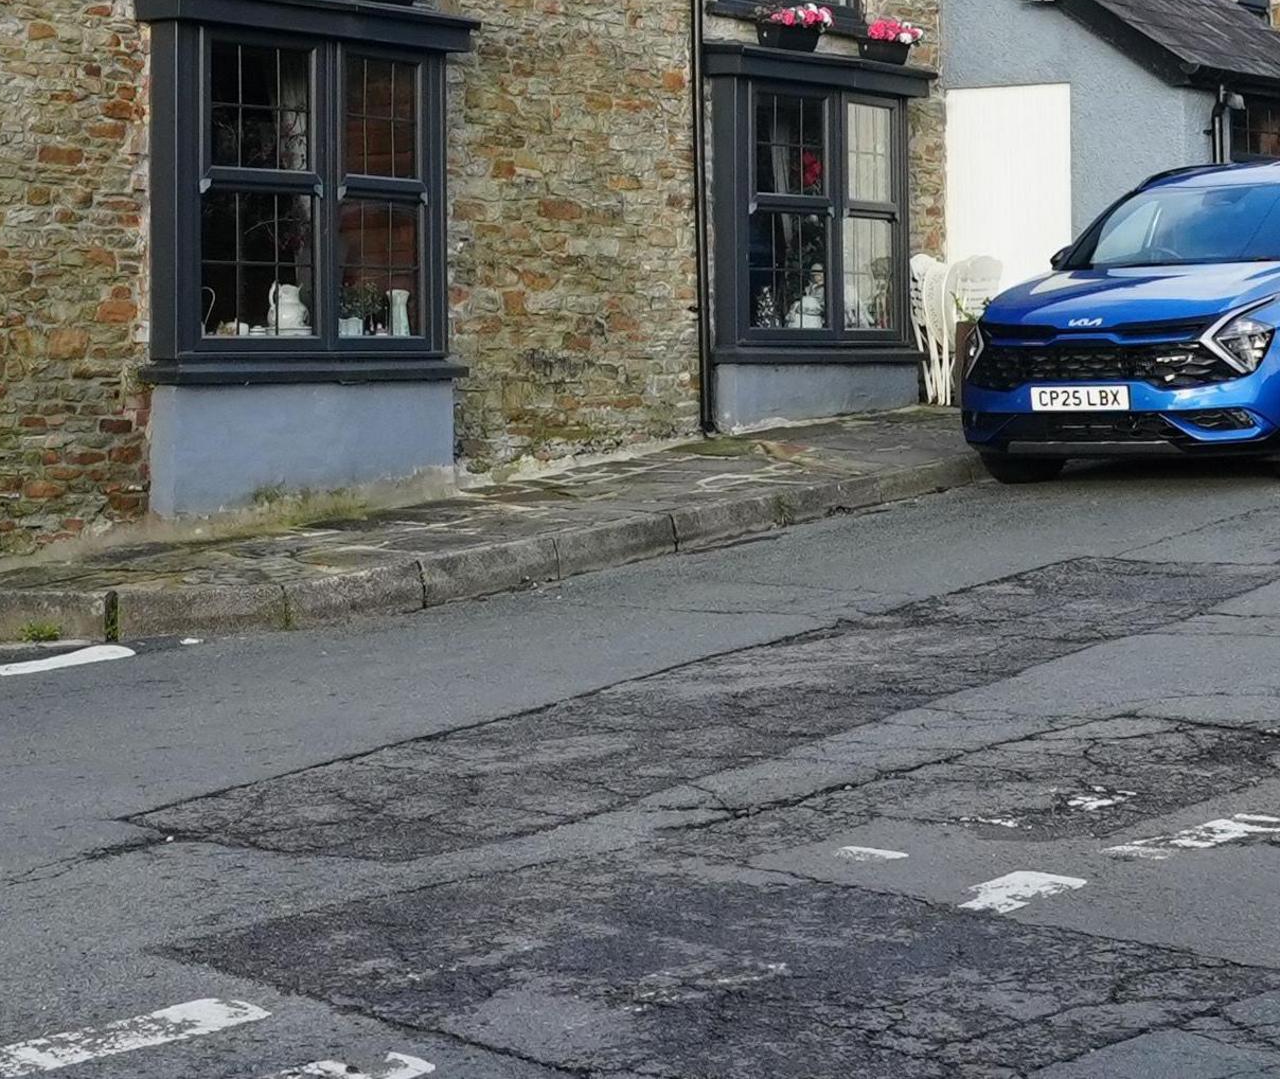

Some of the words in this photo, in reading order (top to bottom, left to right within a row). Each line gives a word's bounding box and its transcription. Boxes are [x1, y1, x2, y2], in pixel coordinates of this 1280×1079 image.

[1068, 317, 1104, 326] KIA
[1038, 390, 1082, 407] CP25
[1087, 390, 1121, 406] LBX
